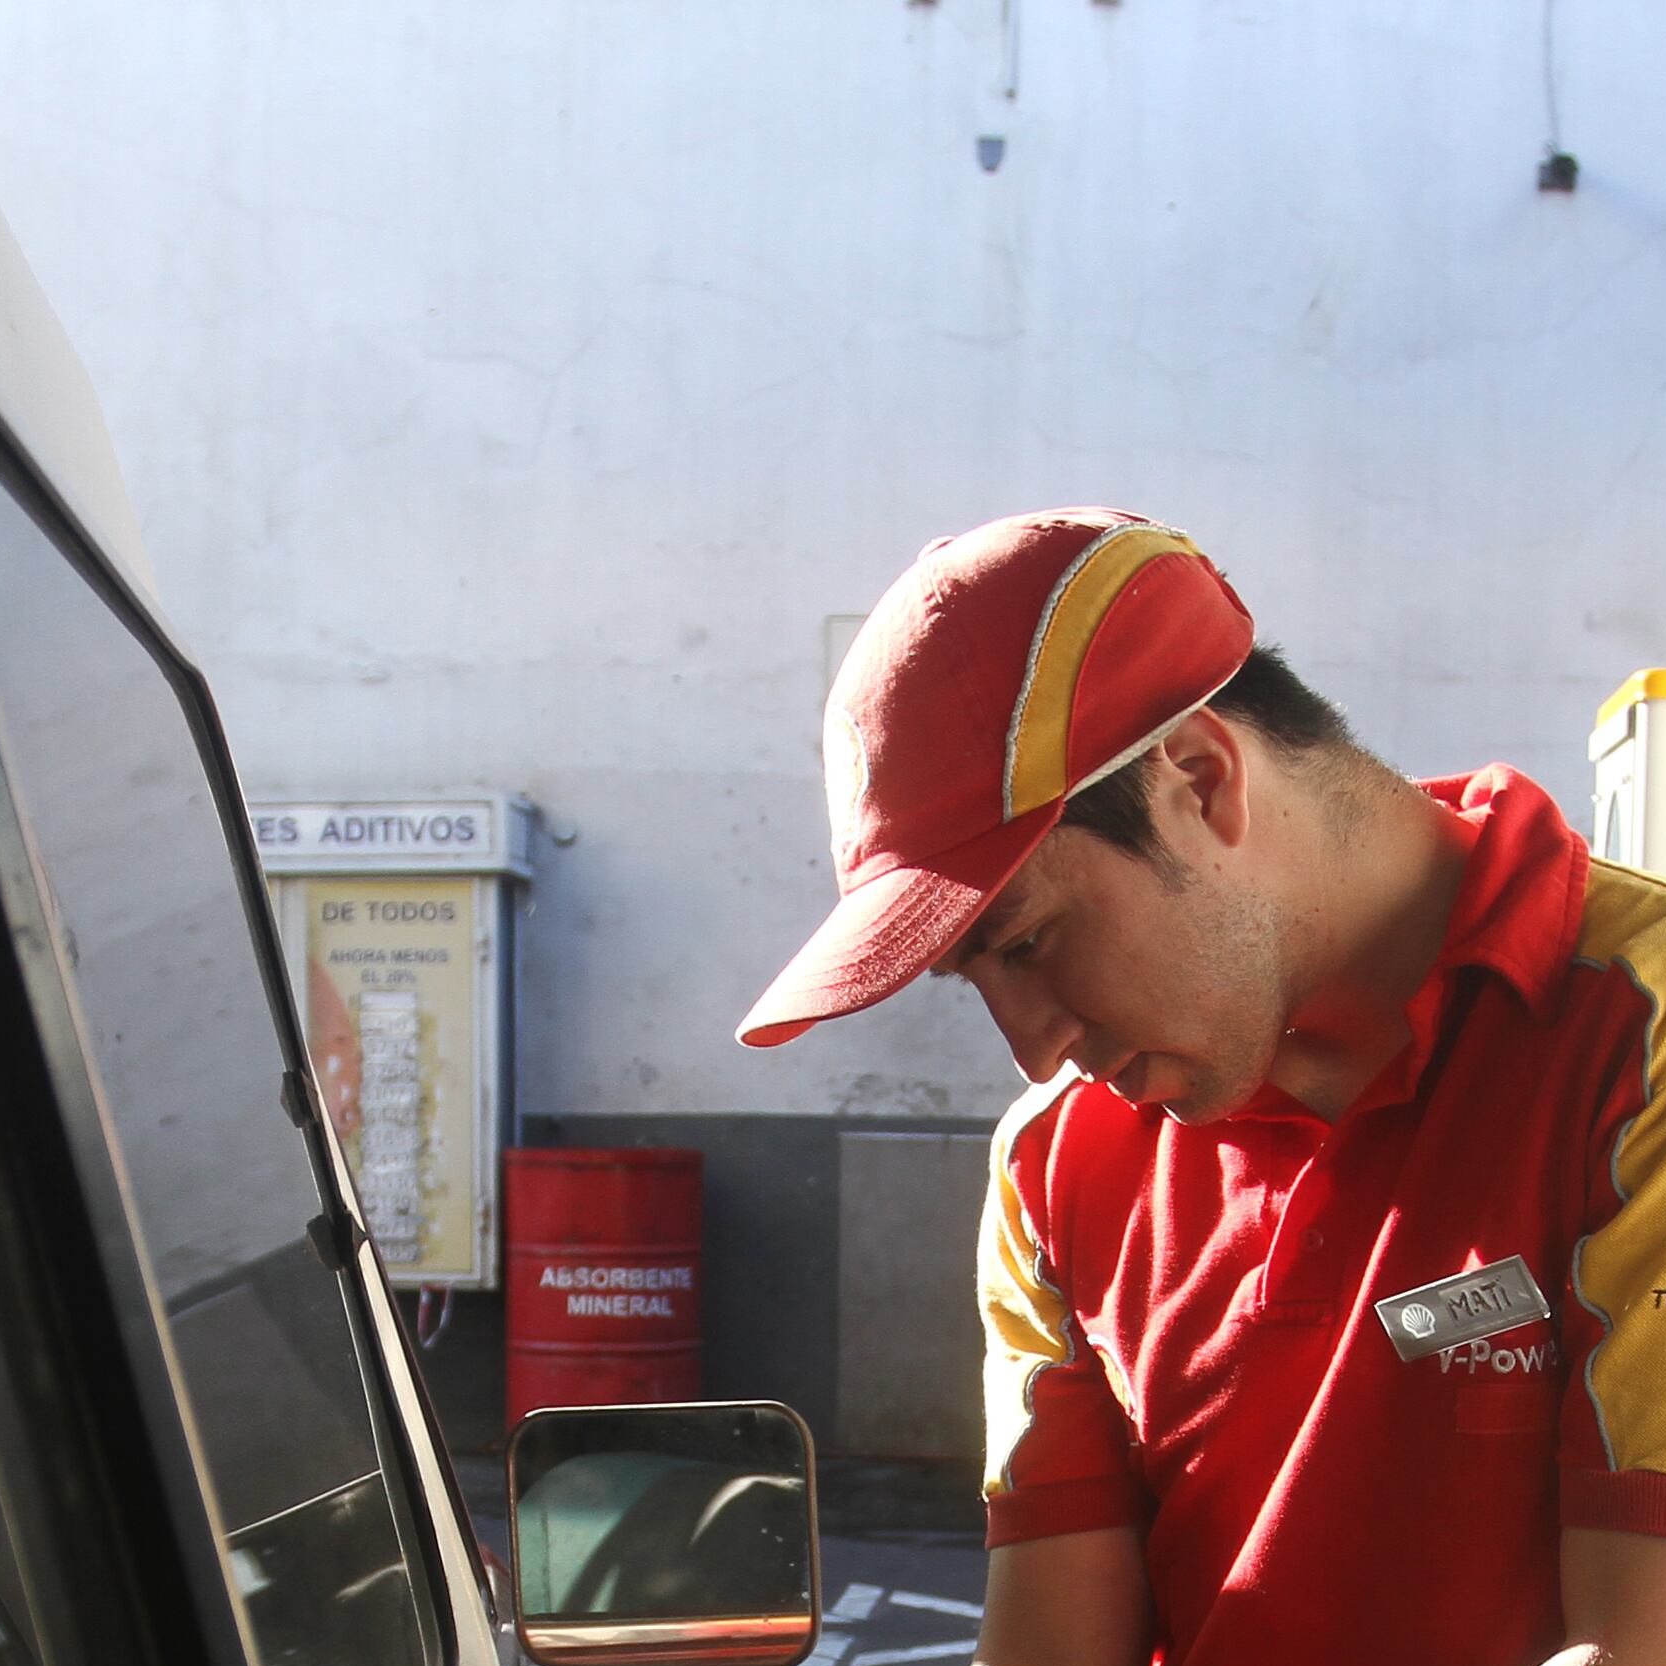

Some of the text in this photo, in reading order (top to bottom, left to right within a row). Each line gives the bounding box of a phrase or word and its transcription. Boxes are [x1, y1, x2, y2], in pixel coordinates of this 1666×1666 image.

[319, 815, 476, 843] ADITIVOS
[322, 901, 457, 923] DE TODOS
[327, 948, 450, 965] AHORA MENOS
[360, 969, 381, 985] EL
[539, 1266, 693, 1290] ABSORBENTE
[566, 1293, 675, 1317] MINERAL
